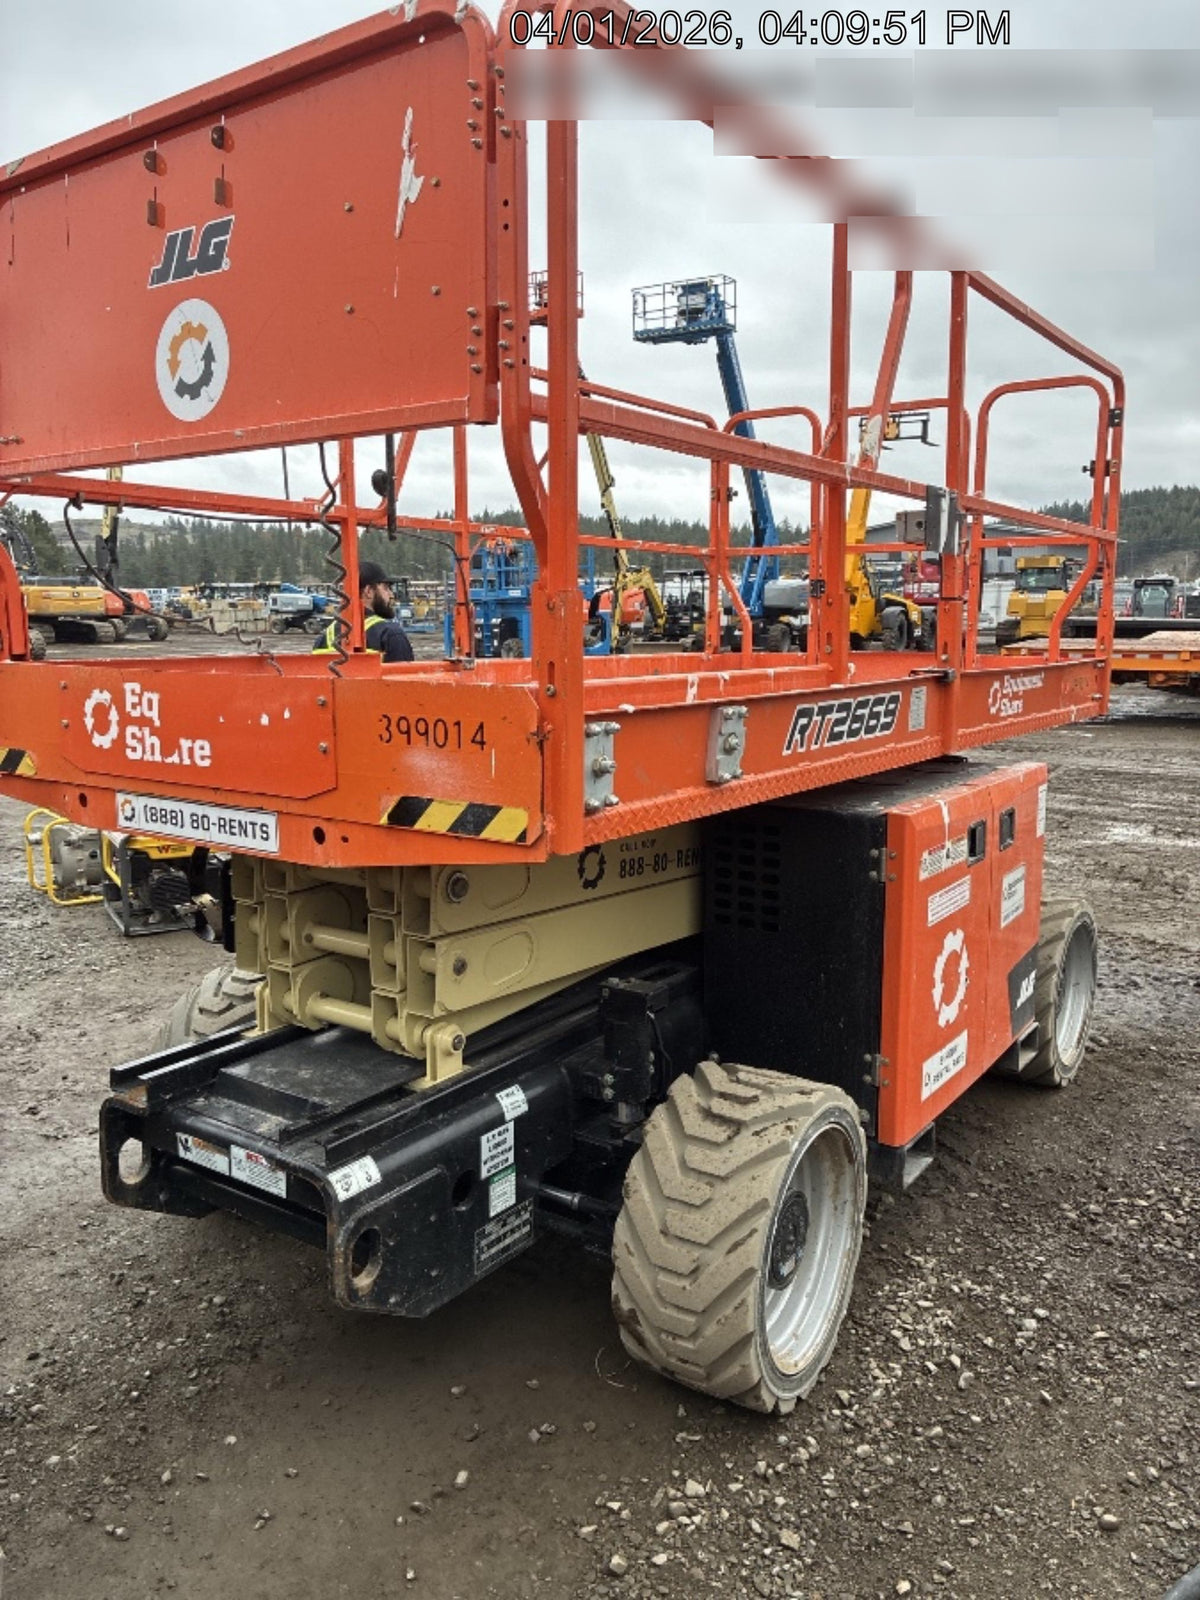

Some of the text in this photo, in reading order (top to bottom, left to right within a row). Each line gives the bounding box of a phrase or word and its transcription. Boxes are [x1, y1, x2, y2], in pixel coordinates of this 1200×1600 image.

[147, 214, 235, 289] JLG
[378, 714, 486, 751] 399014
[782, 691, 902, 757] RT2669
[143, 804, 270, 842] (888) 80-RENTS
[619, 846, 703, 879] 888-80-REN
